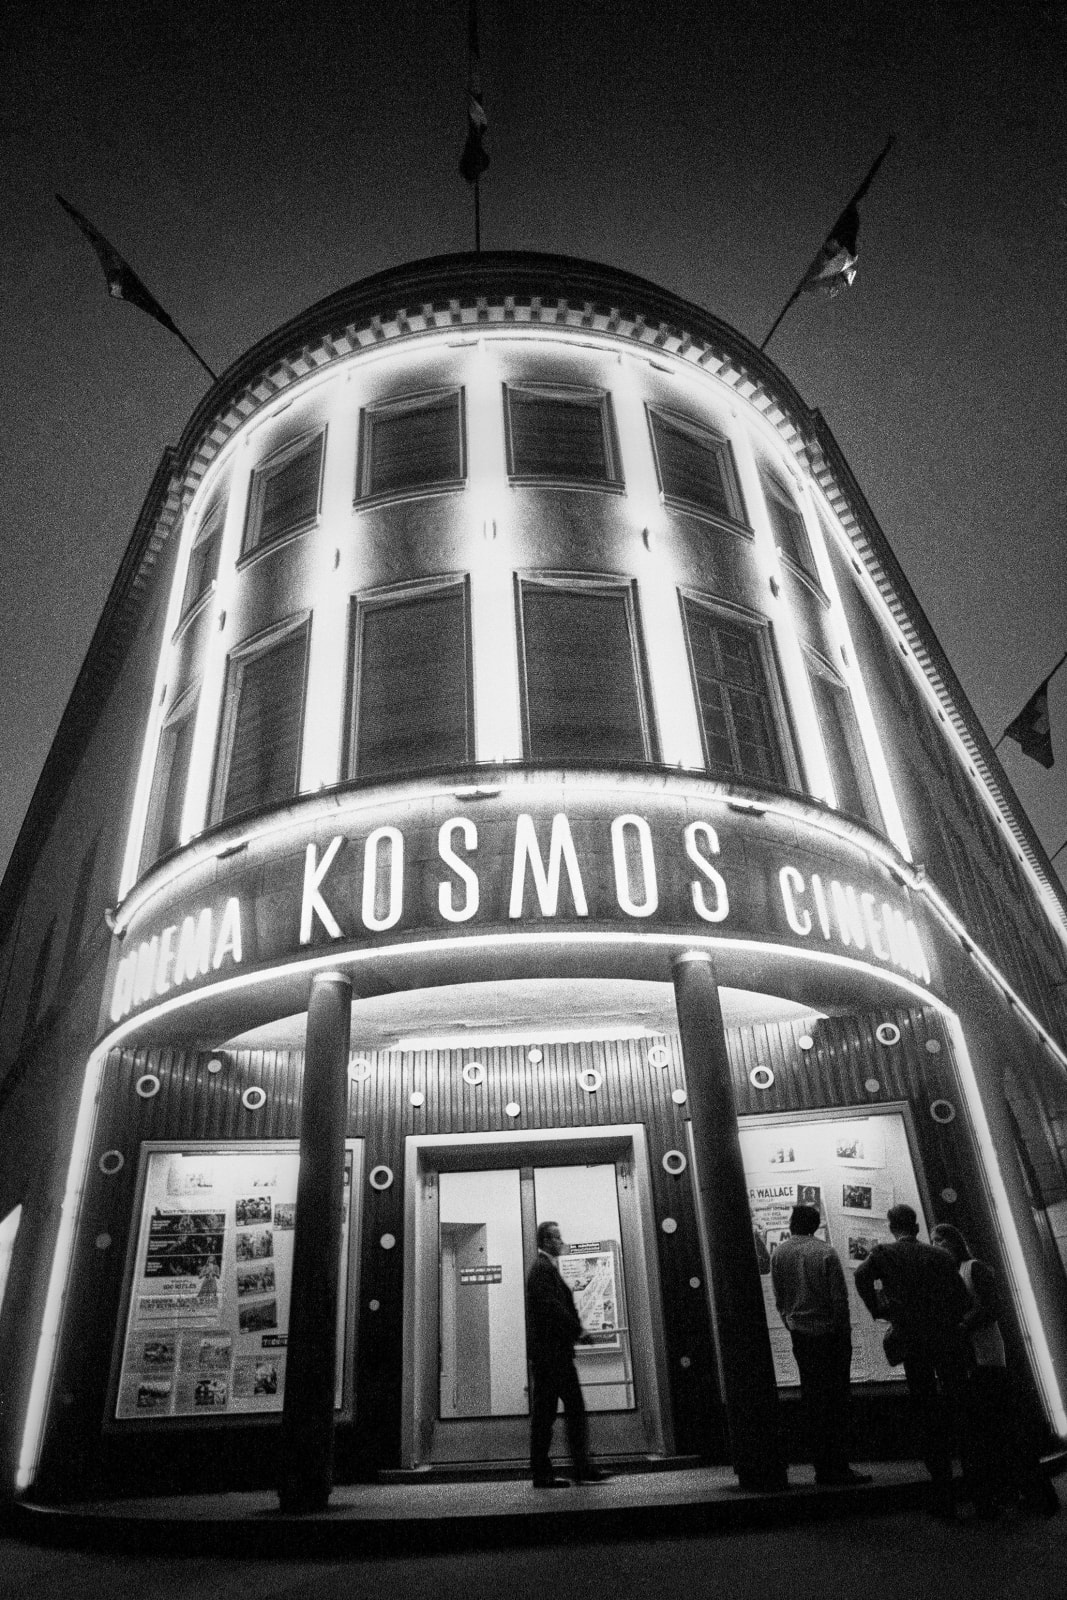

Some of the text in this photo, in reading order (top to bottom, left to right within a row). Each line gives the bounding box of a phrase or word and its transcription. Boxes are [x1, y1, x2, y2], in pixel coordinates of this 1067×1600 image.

[300, 813, 730, 945] KOSMOS
[779, 866, 931, 985] CINEMA
[757, 1186, 794, 1198] WALLACE
